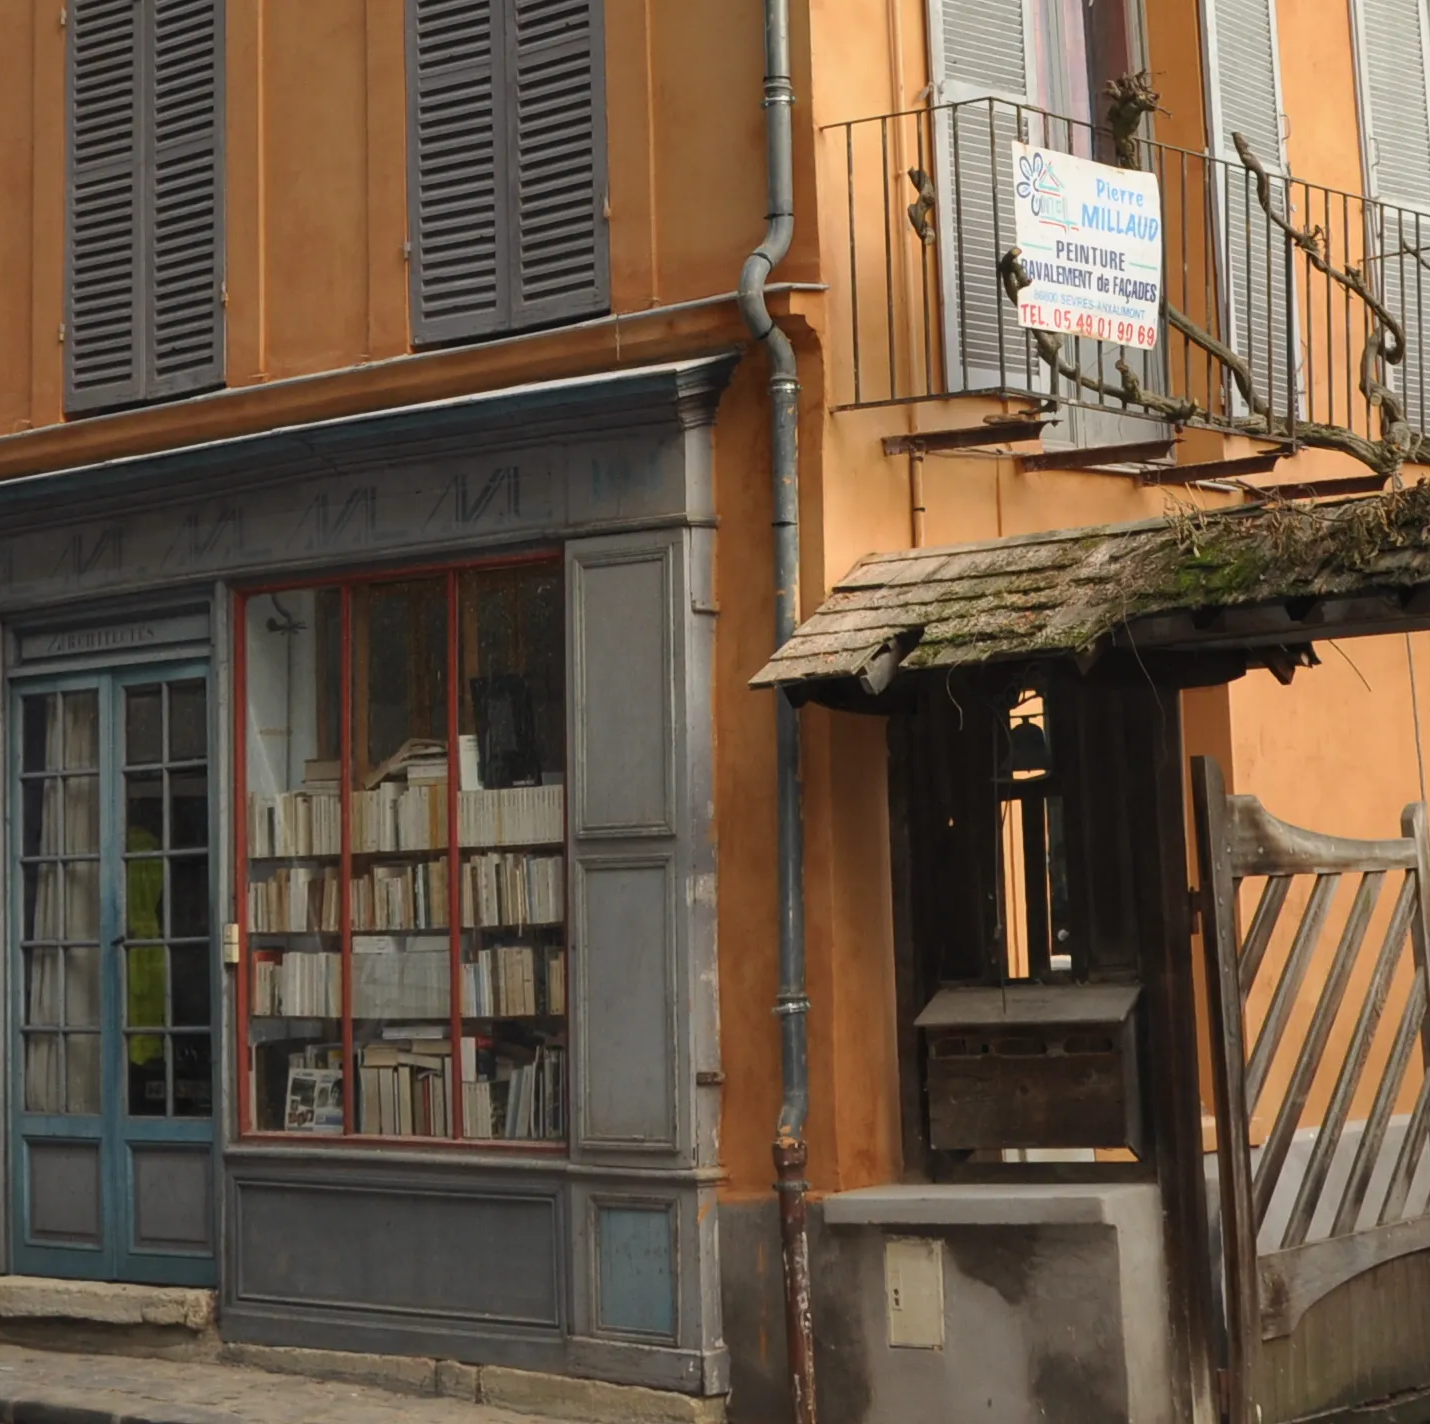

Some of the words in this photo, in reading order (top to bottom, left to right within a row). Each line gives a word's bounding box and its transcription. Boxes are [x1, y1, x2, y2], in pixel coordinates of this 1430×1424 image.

[1096, 178, 1144, 207] Pierre
[1081, 202, 1159, 242] MILLAUD
[1055, 240, 1126, 272] PEINTURE
[1097, 274, 1110, 293] de
[1113, 278, 1158, 304] FAÇADES
[1020, 303, 1050, 326] TEL.
[1054, 308, 1072, 330] 05
[1076, 313, 1093, 335] 49
[1097, 317, 1112, 339] 01
[1117, 321, 1133, 342] 90
[1137, 325, 1155, 347] 69
[48, 626, 154, 653] ARCHITECTES
